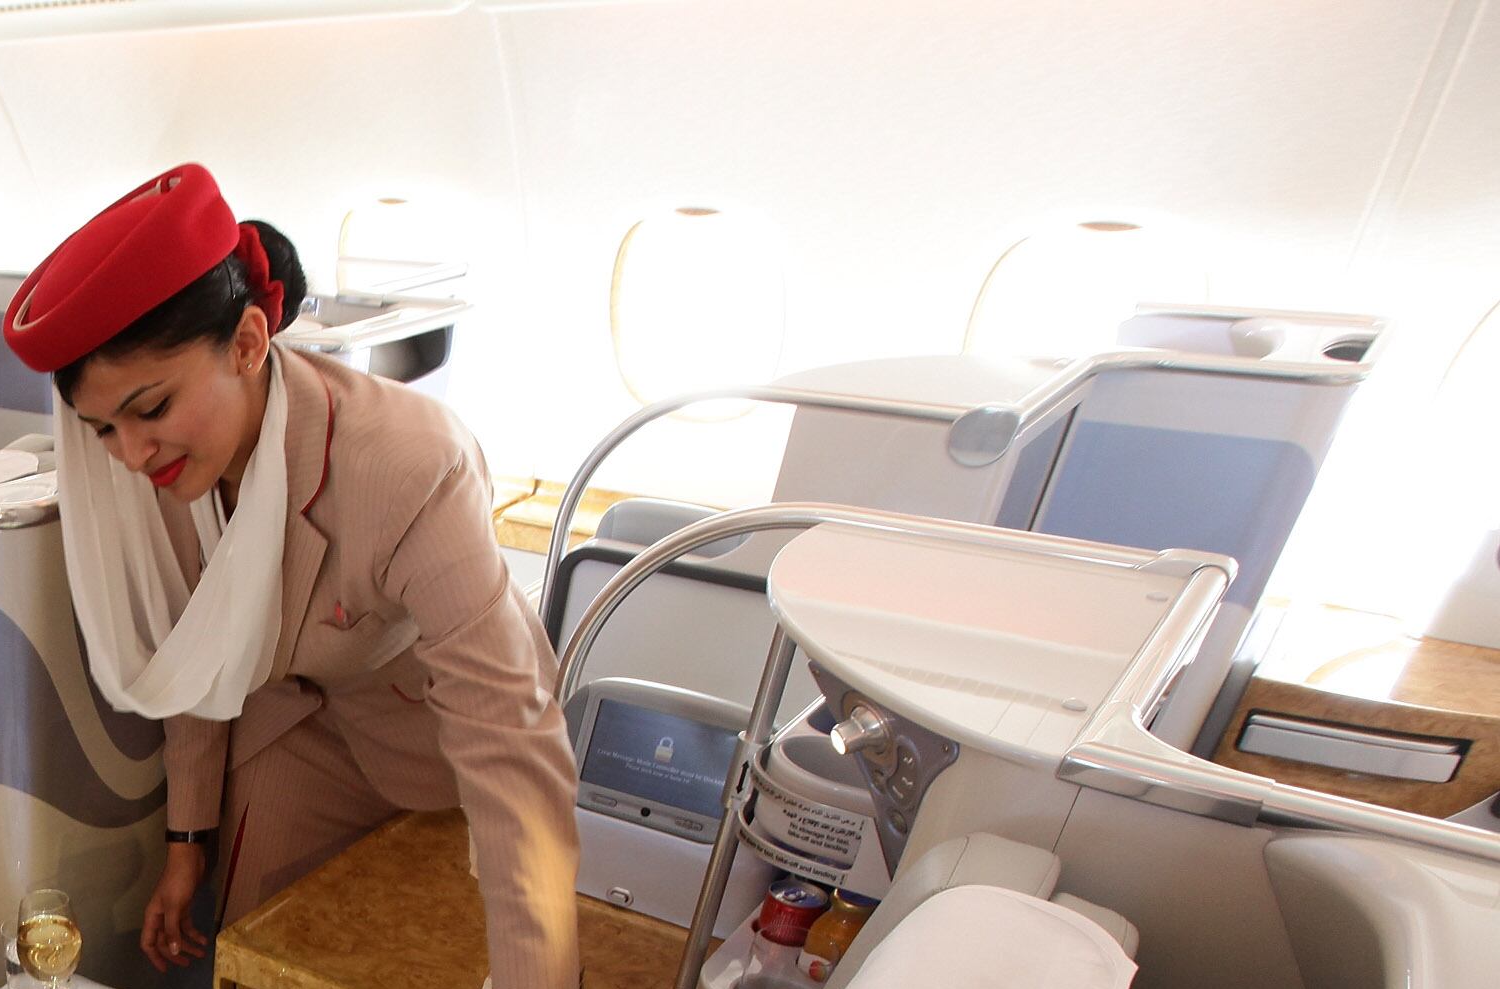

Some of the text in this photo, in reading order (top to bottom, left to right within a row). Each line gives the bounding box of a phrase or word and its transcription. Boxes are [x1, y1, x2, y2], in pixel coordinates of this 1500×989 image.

[810, 838, 823, 847] and
[823, 841, 849, 855] landing
[799, 863, 813, 874] and
[812, 866, 838, 882] landing
